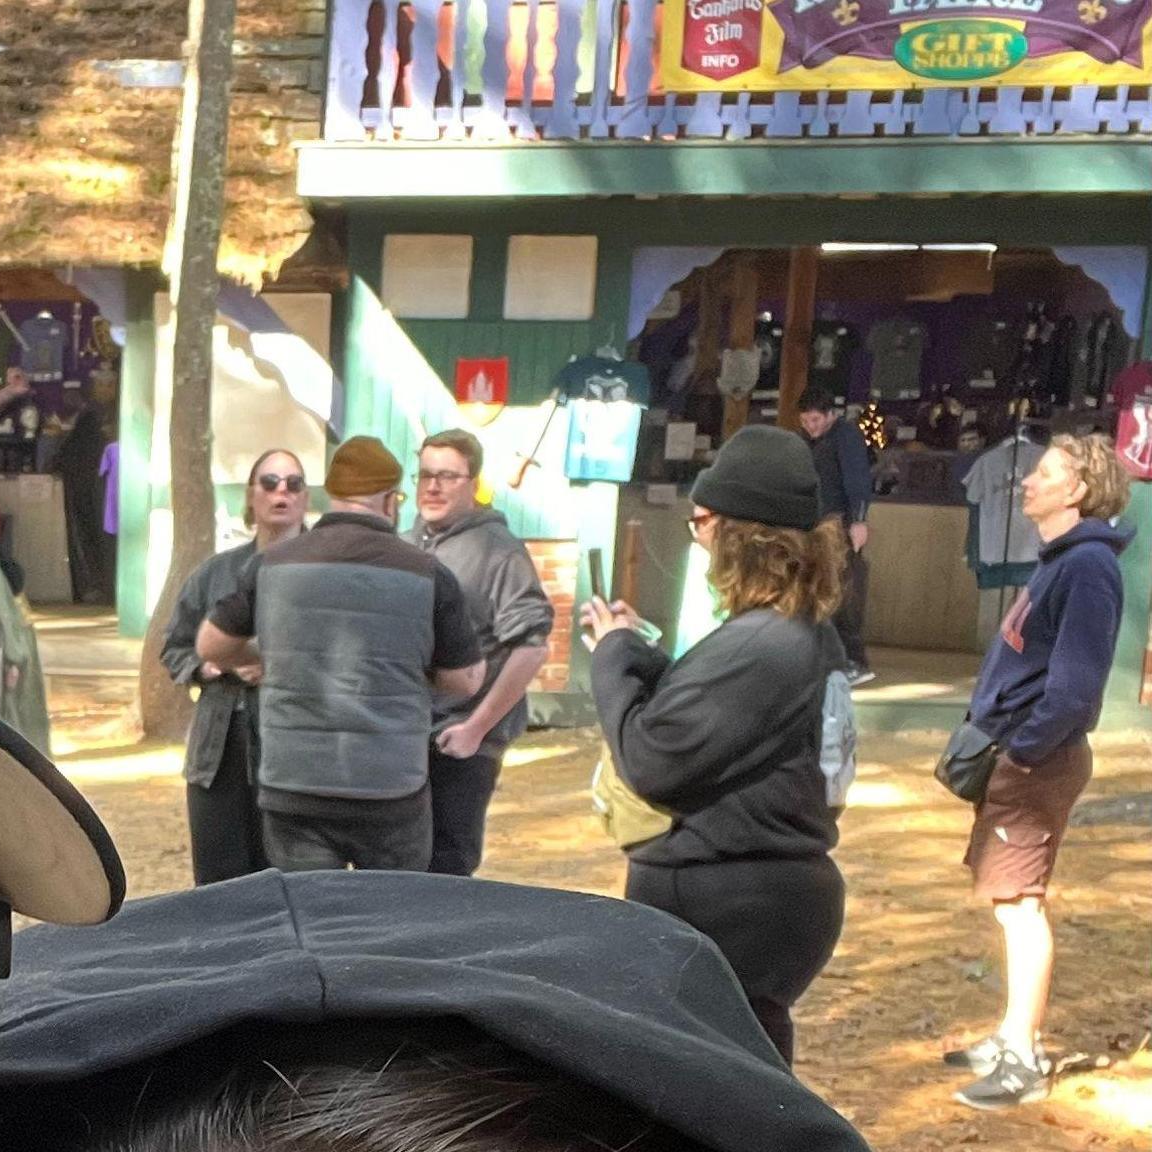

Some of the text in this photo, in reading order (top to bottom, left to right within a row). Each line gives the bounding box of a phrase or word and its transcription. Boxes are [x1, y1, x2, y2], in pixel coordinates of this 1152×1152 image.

[705, 21, 743, 45] Film
[912, 32, 1012, 53] GIFT
[701, 54, 740, 68] INFO
[913, 51, 1011, 70] SHOPPE
